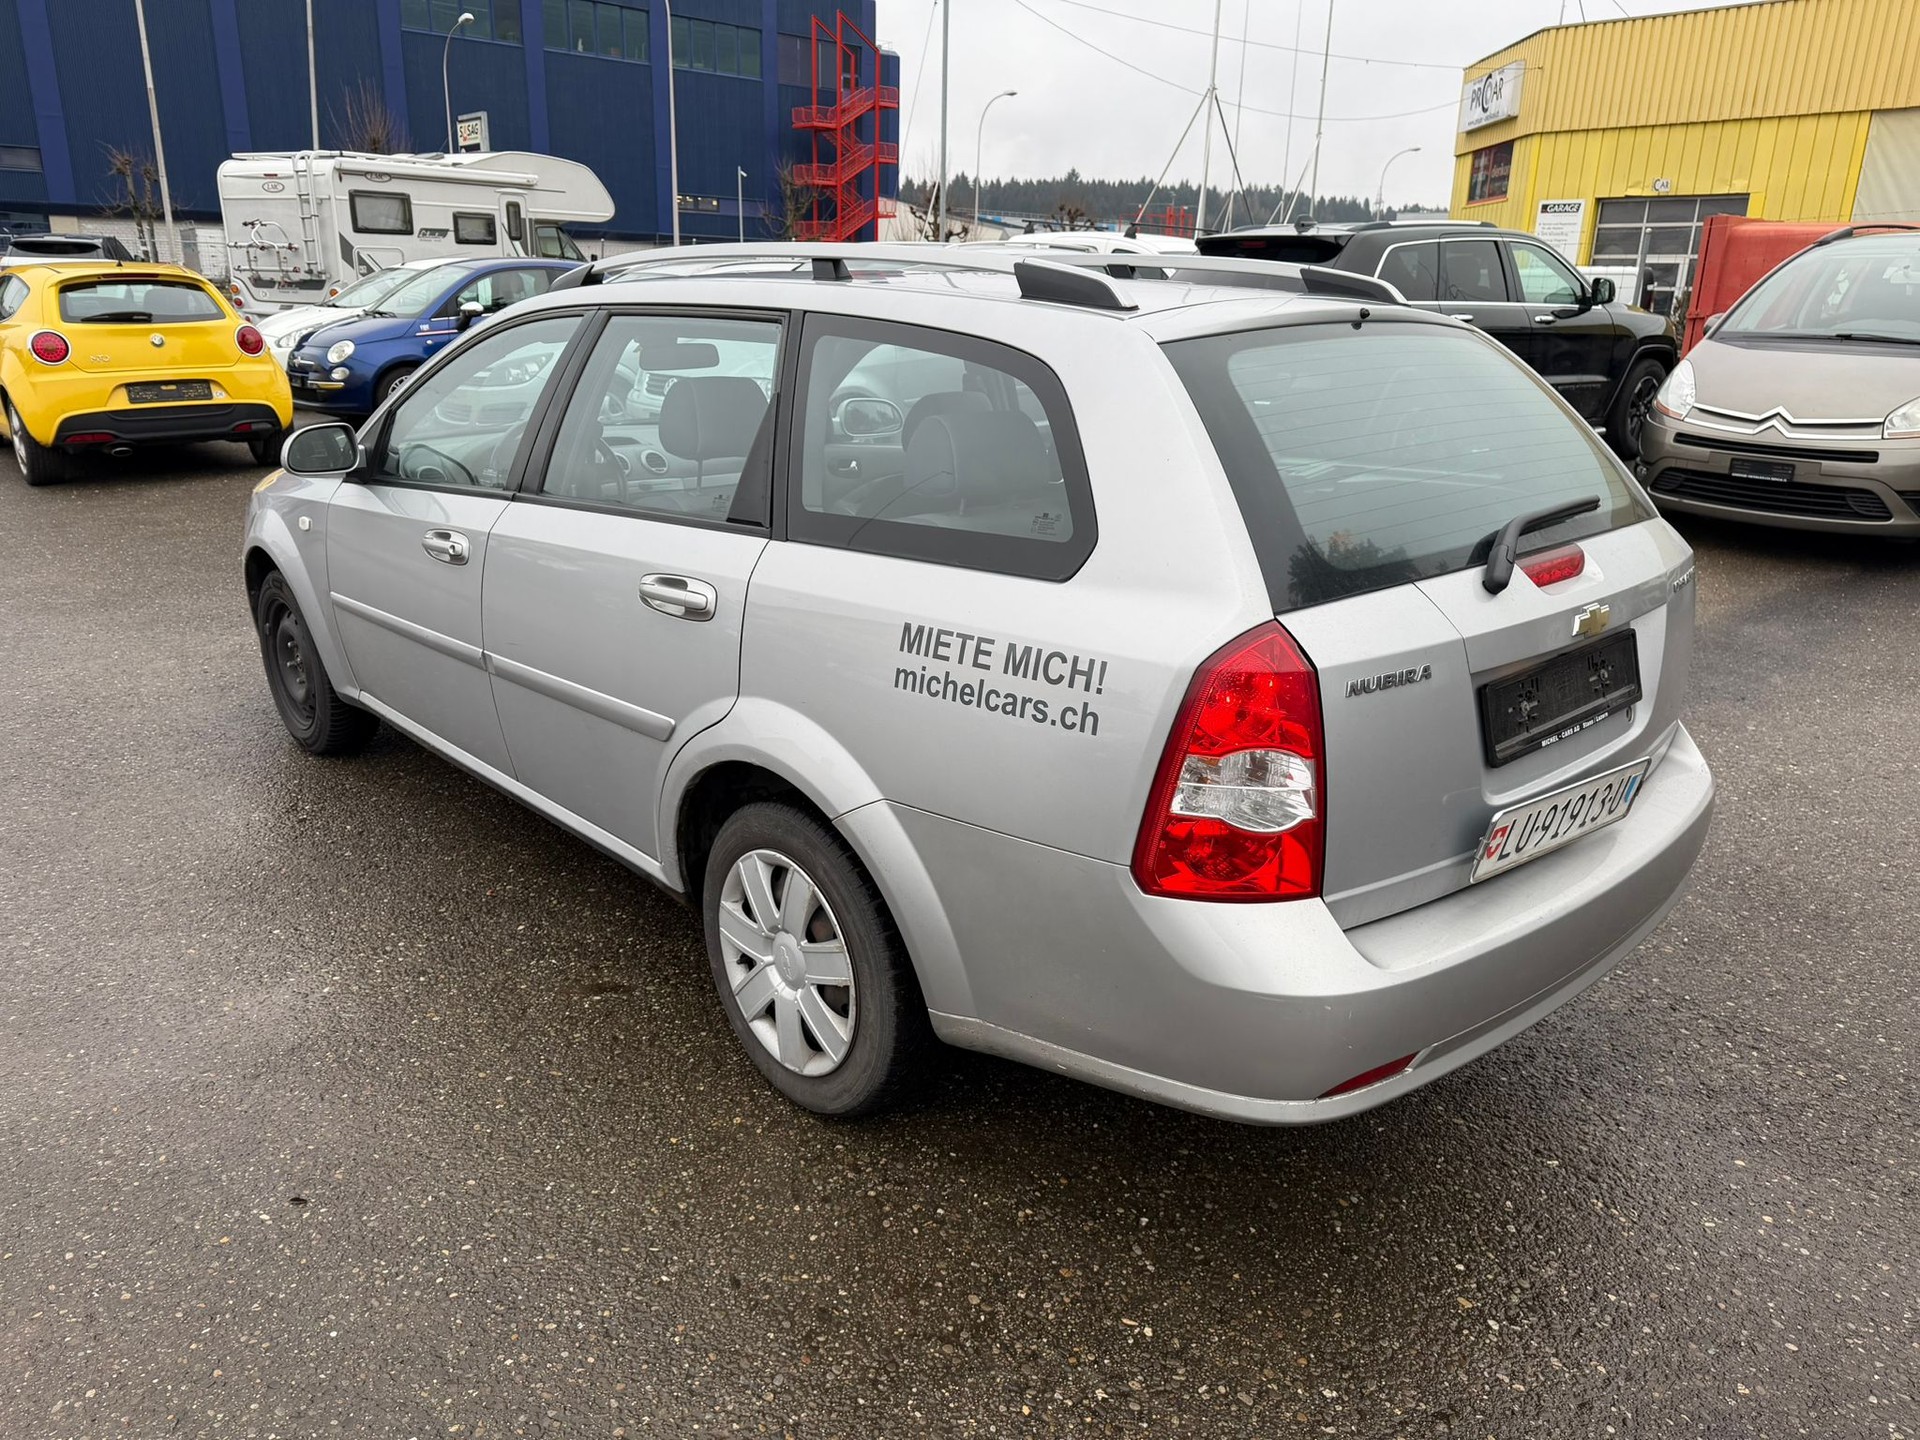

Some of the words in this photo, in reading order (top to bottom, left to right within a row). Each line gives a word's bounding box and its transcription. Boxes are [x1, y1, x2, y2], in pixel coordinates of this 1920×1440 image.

[1547, 204, 1580, 212] GARAGE
[899, 622, 995, 671] MIETE
[1003, 642, 1108, 695] MICH!
[1344, 663, 1432, 698] NUBIRA
[894, 665, 1099, 736] michelcars.ch
